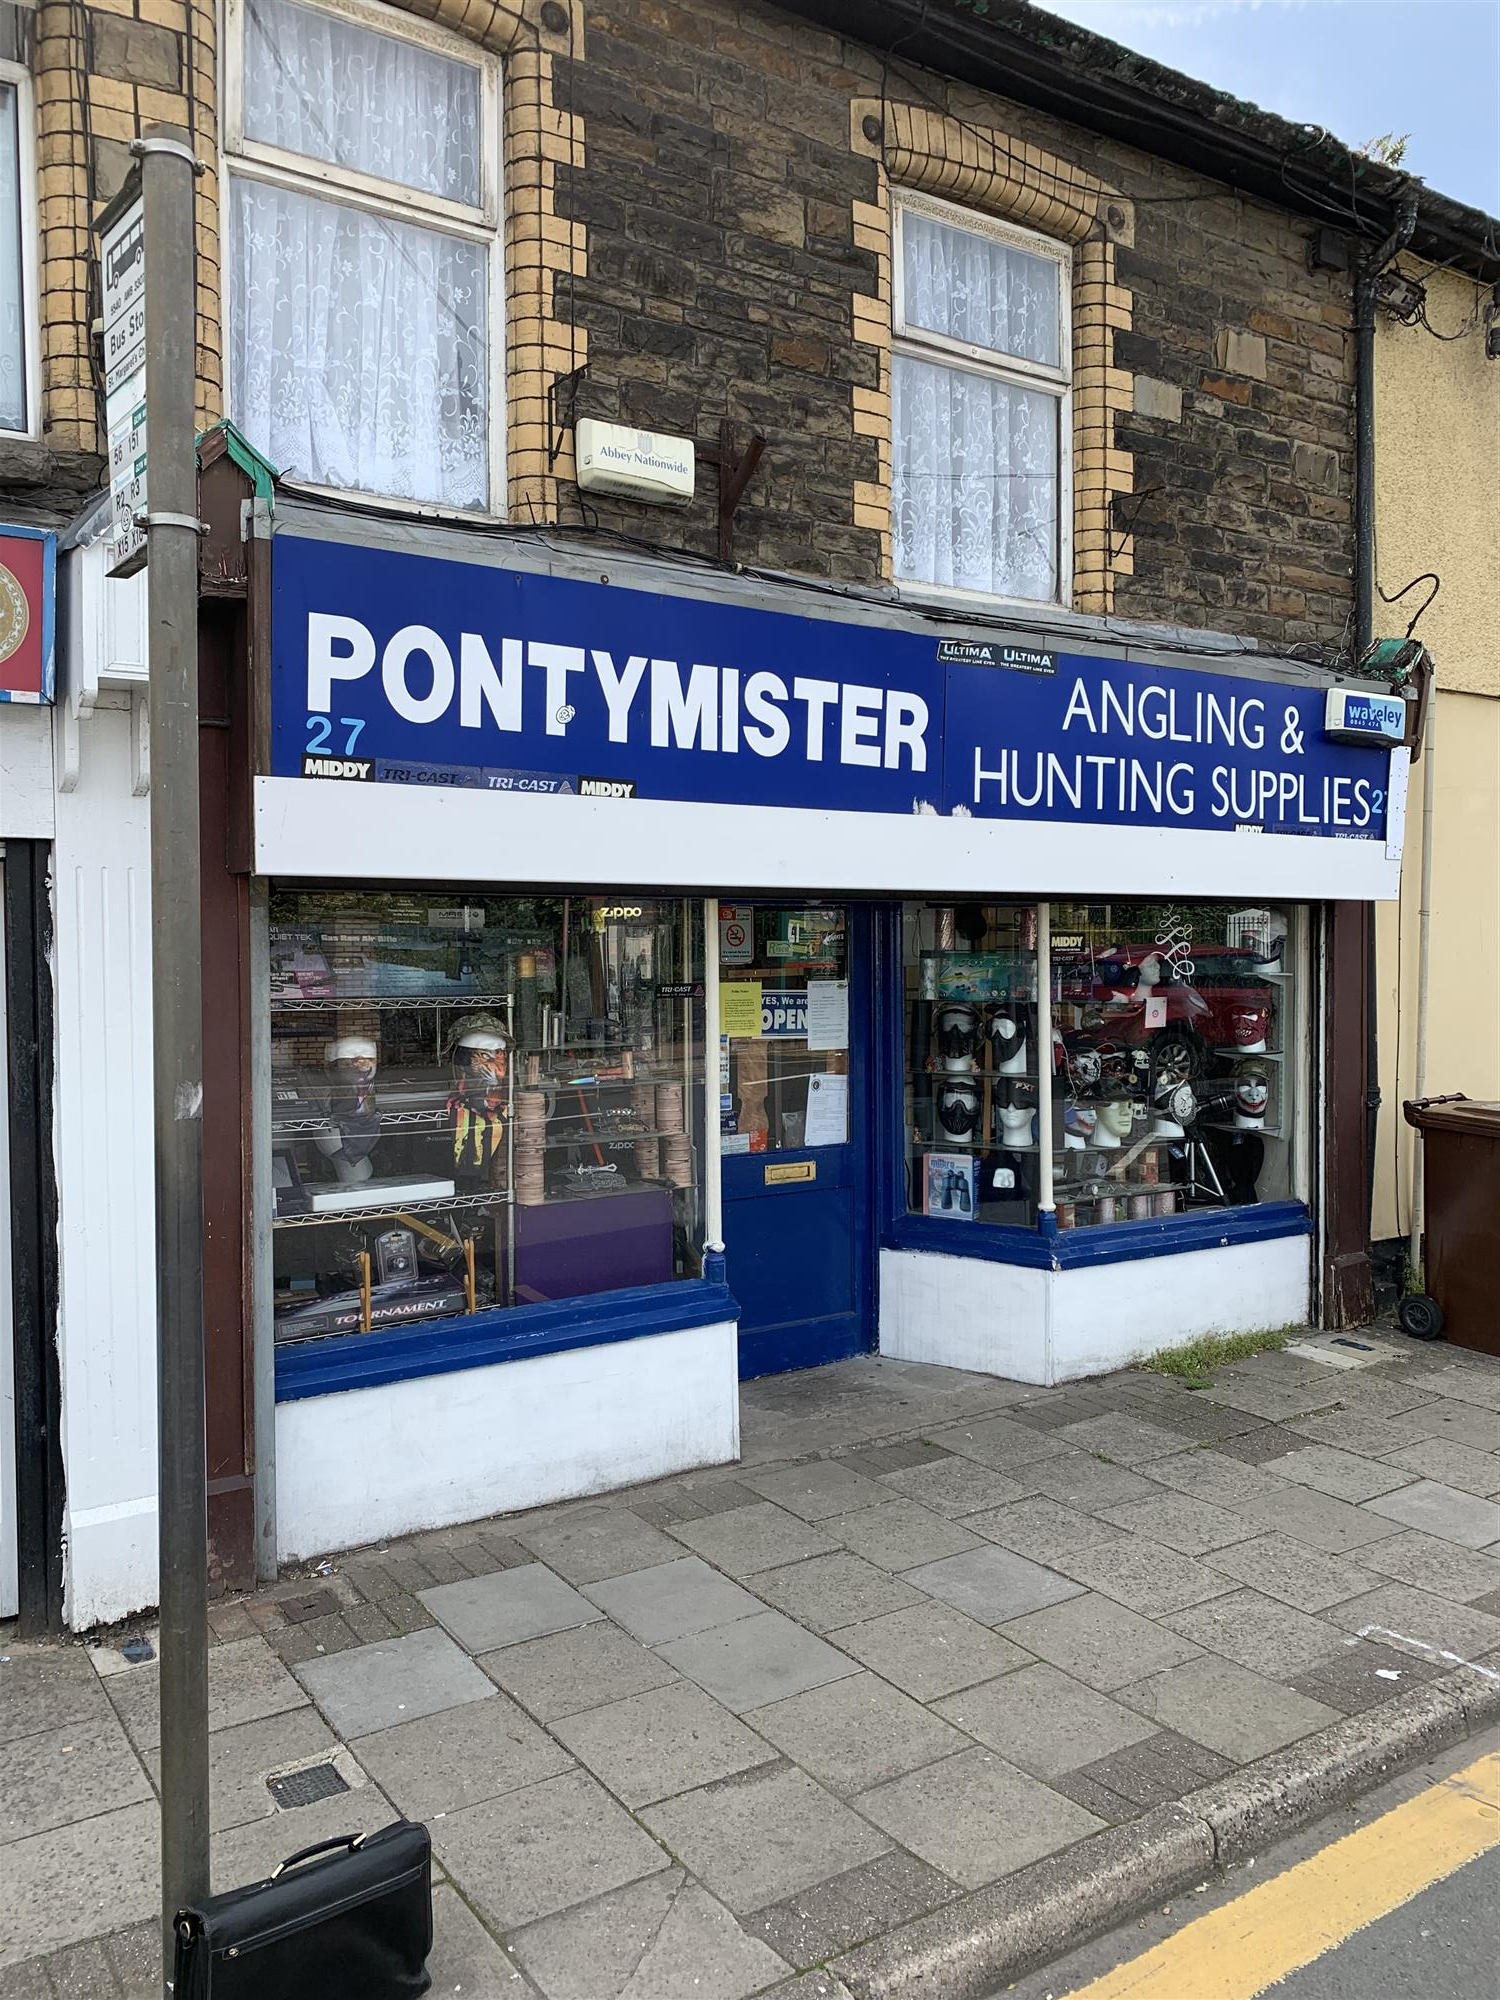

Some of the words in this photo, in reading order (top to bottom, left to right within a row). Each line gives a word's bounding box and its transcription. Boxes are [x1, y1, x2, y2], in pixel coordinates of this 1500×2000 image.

[111, 329, 126, 356] Bus
[130, 311, 144, 337] Sto
[114, 444, 123, 466] 56
[128, 429, 139, 453] 151
[600, 446, 632, 463] Abbey
[634, 456, 689, 474] Nationwide
[116, 490, 125, 512] R2
[131, 478, 140, 499] R3
[117, 535, 129, 558] X15
[1003, 648, 1053, 668] ULTIMA
[308, 611, 930, 773] PONTYMISTER
[1062, 677, 1265, 750] ANGLING
[1280, 706, 1305, 754] &
[305, 716, 366, 755] 27
[305, 759, 371, 778] MIDDY
[384, 768, 459, 784] TRI-CAST
[488, 776, 558, 792] TRI-CAST
[581, 780, 634, 798] MIDDY
[974, 747, 1194, 815] HUNTING
[1211, 766, 1371, 826] SUPPLIES
[1371, 789, 1388, 814] 2
[1051, 936, 1083, 947] MIDDY
[782, 997, 794, 1005] We
[762, 1008, 808, 1030] OPEN
